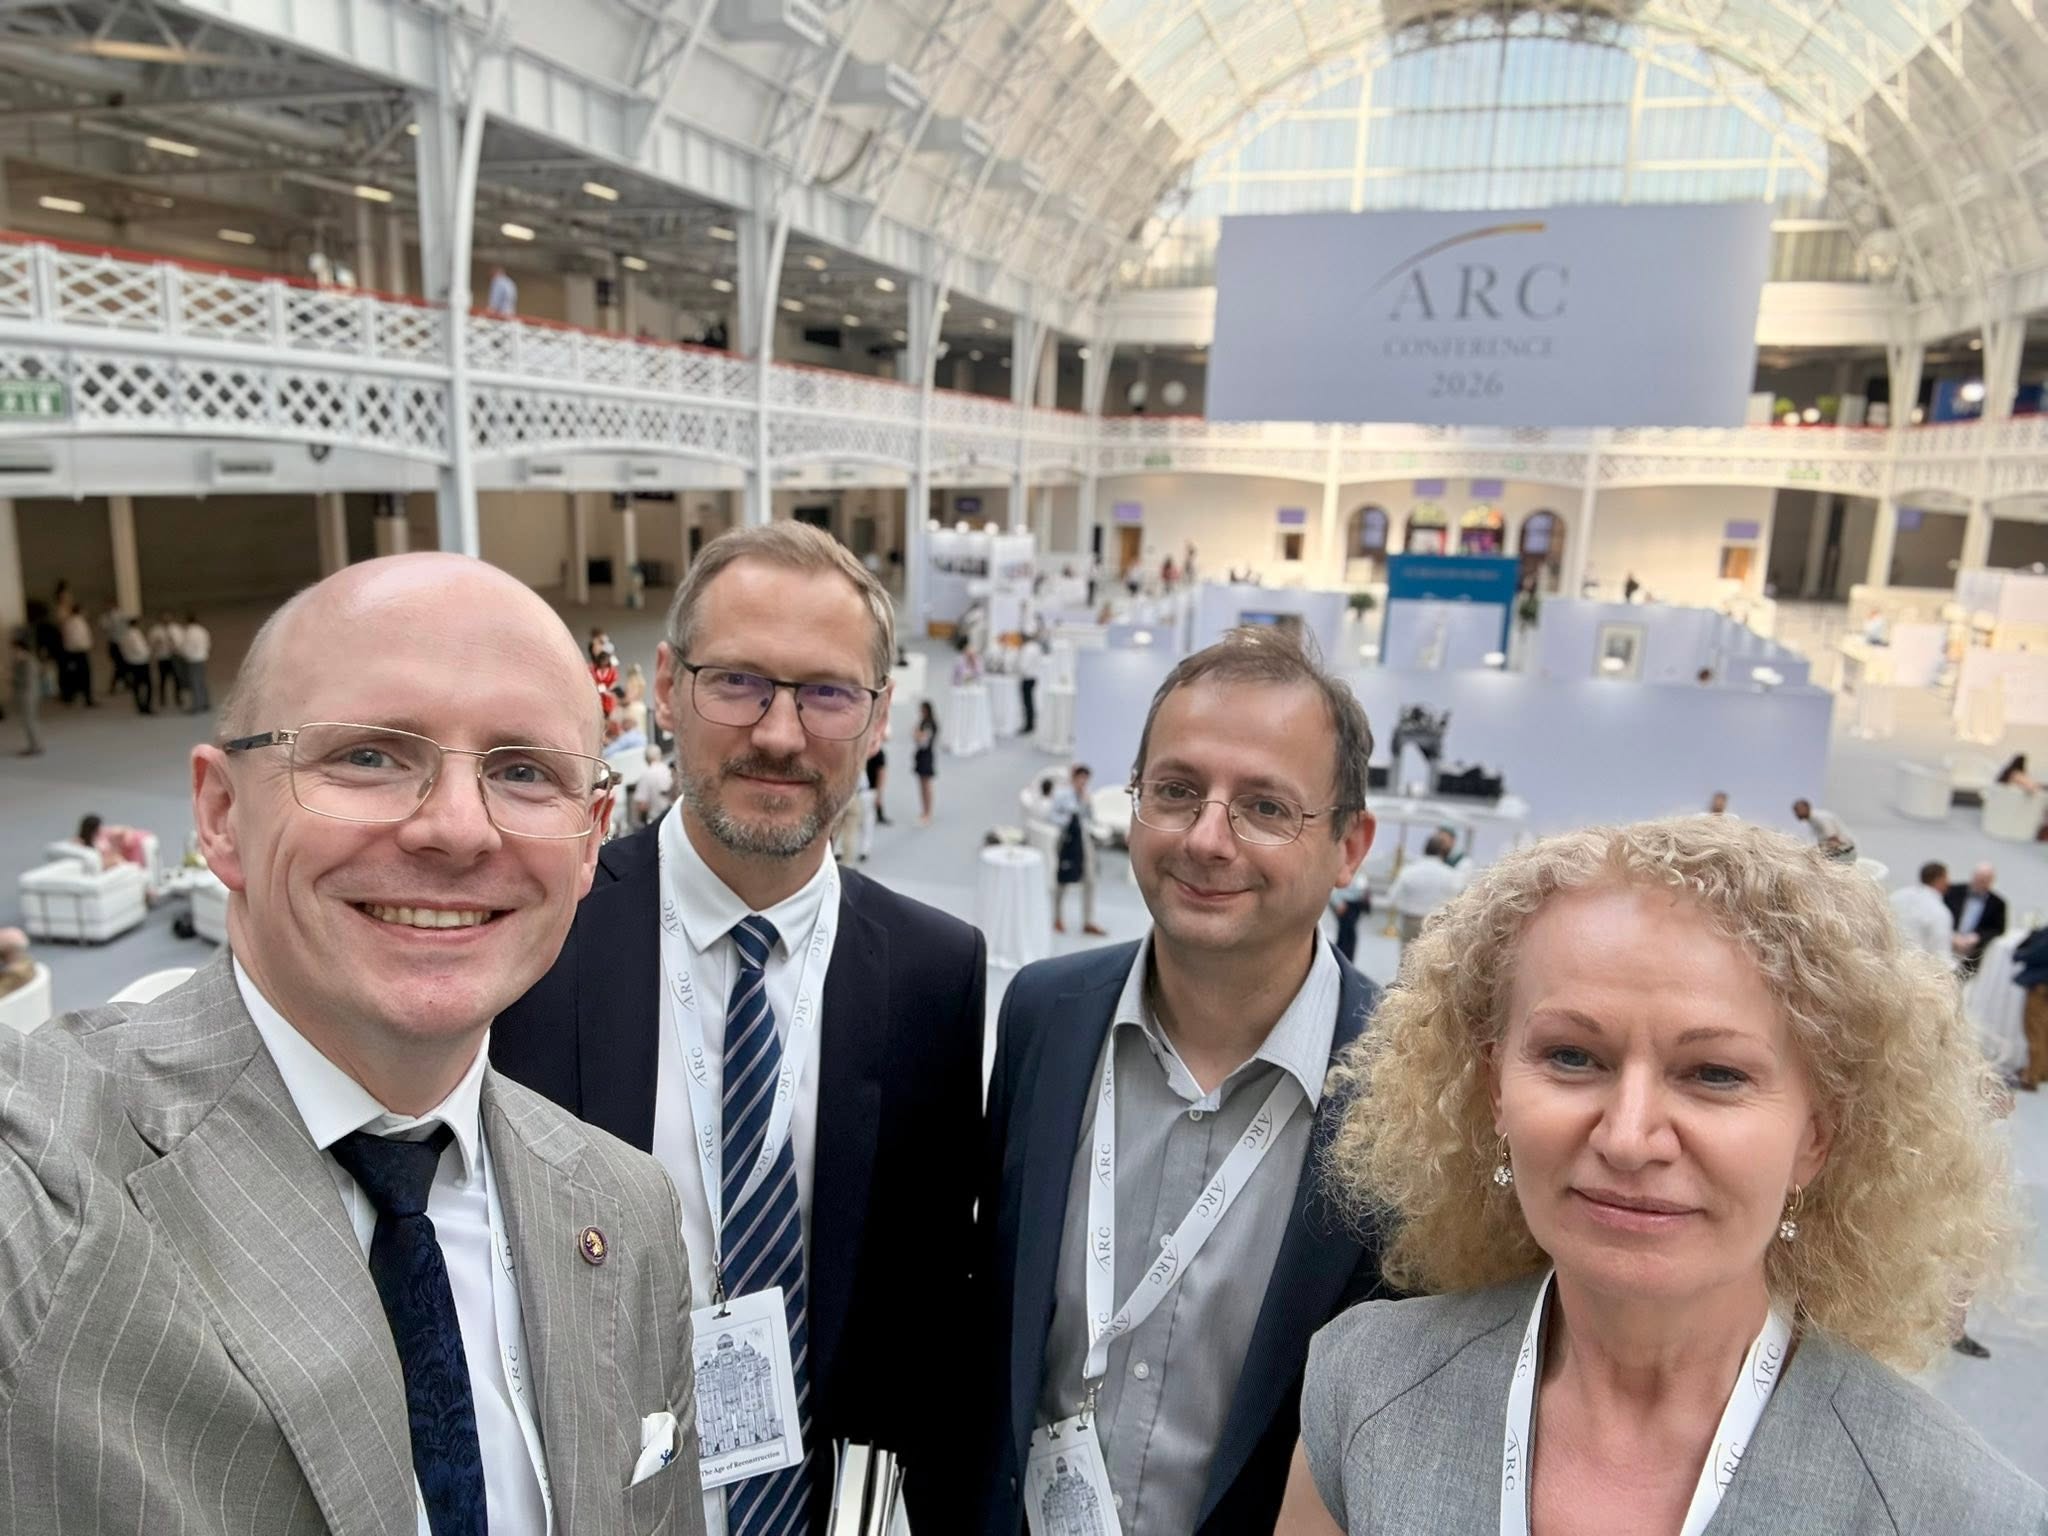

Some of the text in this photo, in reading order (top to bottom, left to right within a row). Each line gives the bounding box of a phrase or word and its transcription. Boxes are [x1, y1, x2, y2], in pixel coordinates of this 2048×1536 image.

[1387, 262, 1572, 322] ARC
[1382, 335, 1554, 358] CONFERENCE
[1429, 369, 1504, 398] 2026
[663, 899, 680, 933] ARC
[809, 923, 826, 958] ARC
[677, 970, 695, 1006] ARC
[793, 992, 809, 1028] ARC
[691, 1046, 707, 1082] ARC
[778, 1067, 793, 1102] ARC
[704, 1124, 714, 1160] ARC
[1244, 1113, 1270, 1150] ARC
[753, 1141, 773, 1178] ARC
[1101, 1143, 1111, 1181] ARC
[1196, 1180, 1223, 1219] ARC
[1099, 1226, 1111, 1266] ARC
[1150, 1252, 1177, 1286] ARC
[1755, 1343, 1780, 1393] ARC
[701, 1468, 713, 1478] The
[714, 1465, 726, 1475] Age
[734, 1450, 780, 1469] Reconstruction
